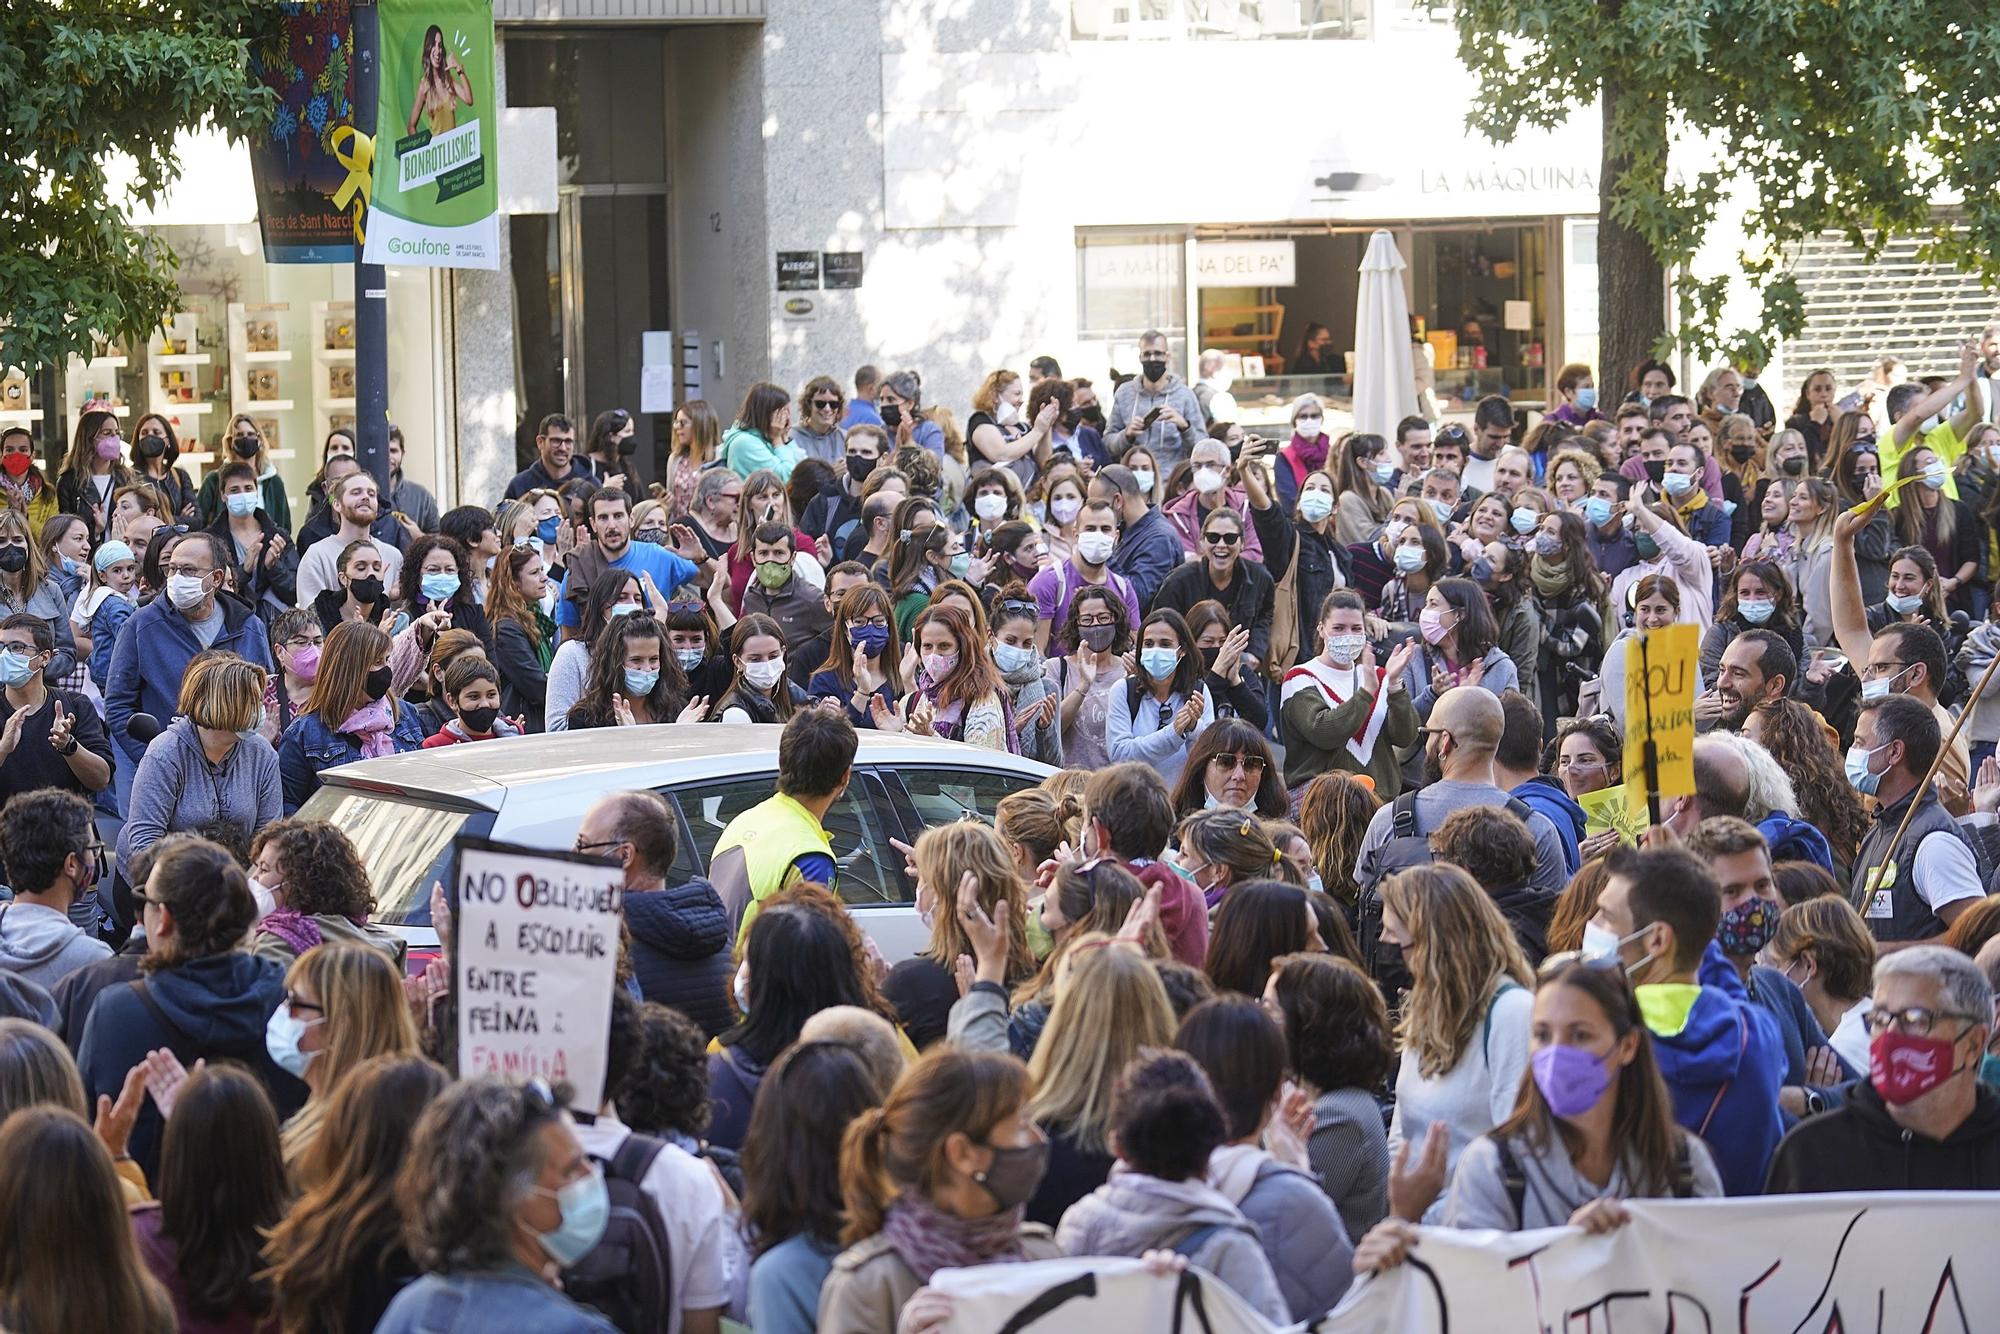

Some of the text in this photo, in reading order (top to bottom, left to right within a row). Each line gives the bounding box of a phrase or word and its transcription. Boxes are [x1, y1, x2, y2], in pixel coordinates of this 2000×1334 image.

[405, 130, 476, 182] BONROTLLISME!
[1421, 168, 1450, 194] LA
[287, 213, 298, 229] de
[299, 213, 321, 229] Sant
[709, 212, 721, 232] 12
[388, 237, 450, 256] Goufone
[1224, 255, 1253, 273] DEL
[466, 871, 505, 904] NO
[485, 920, 498, 949] A
[467, 966, 537, 998] ENTRE
